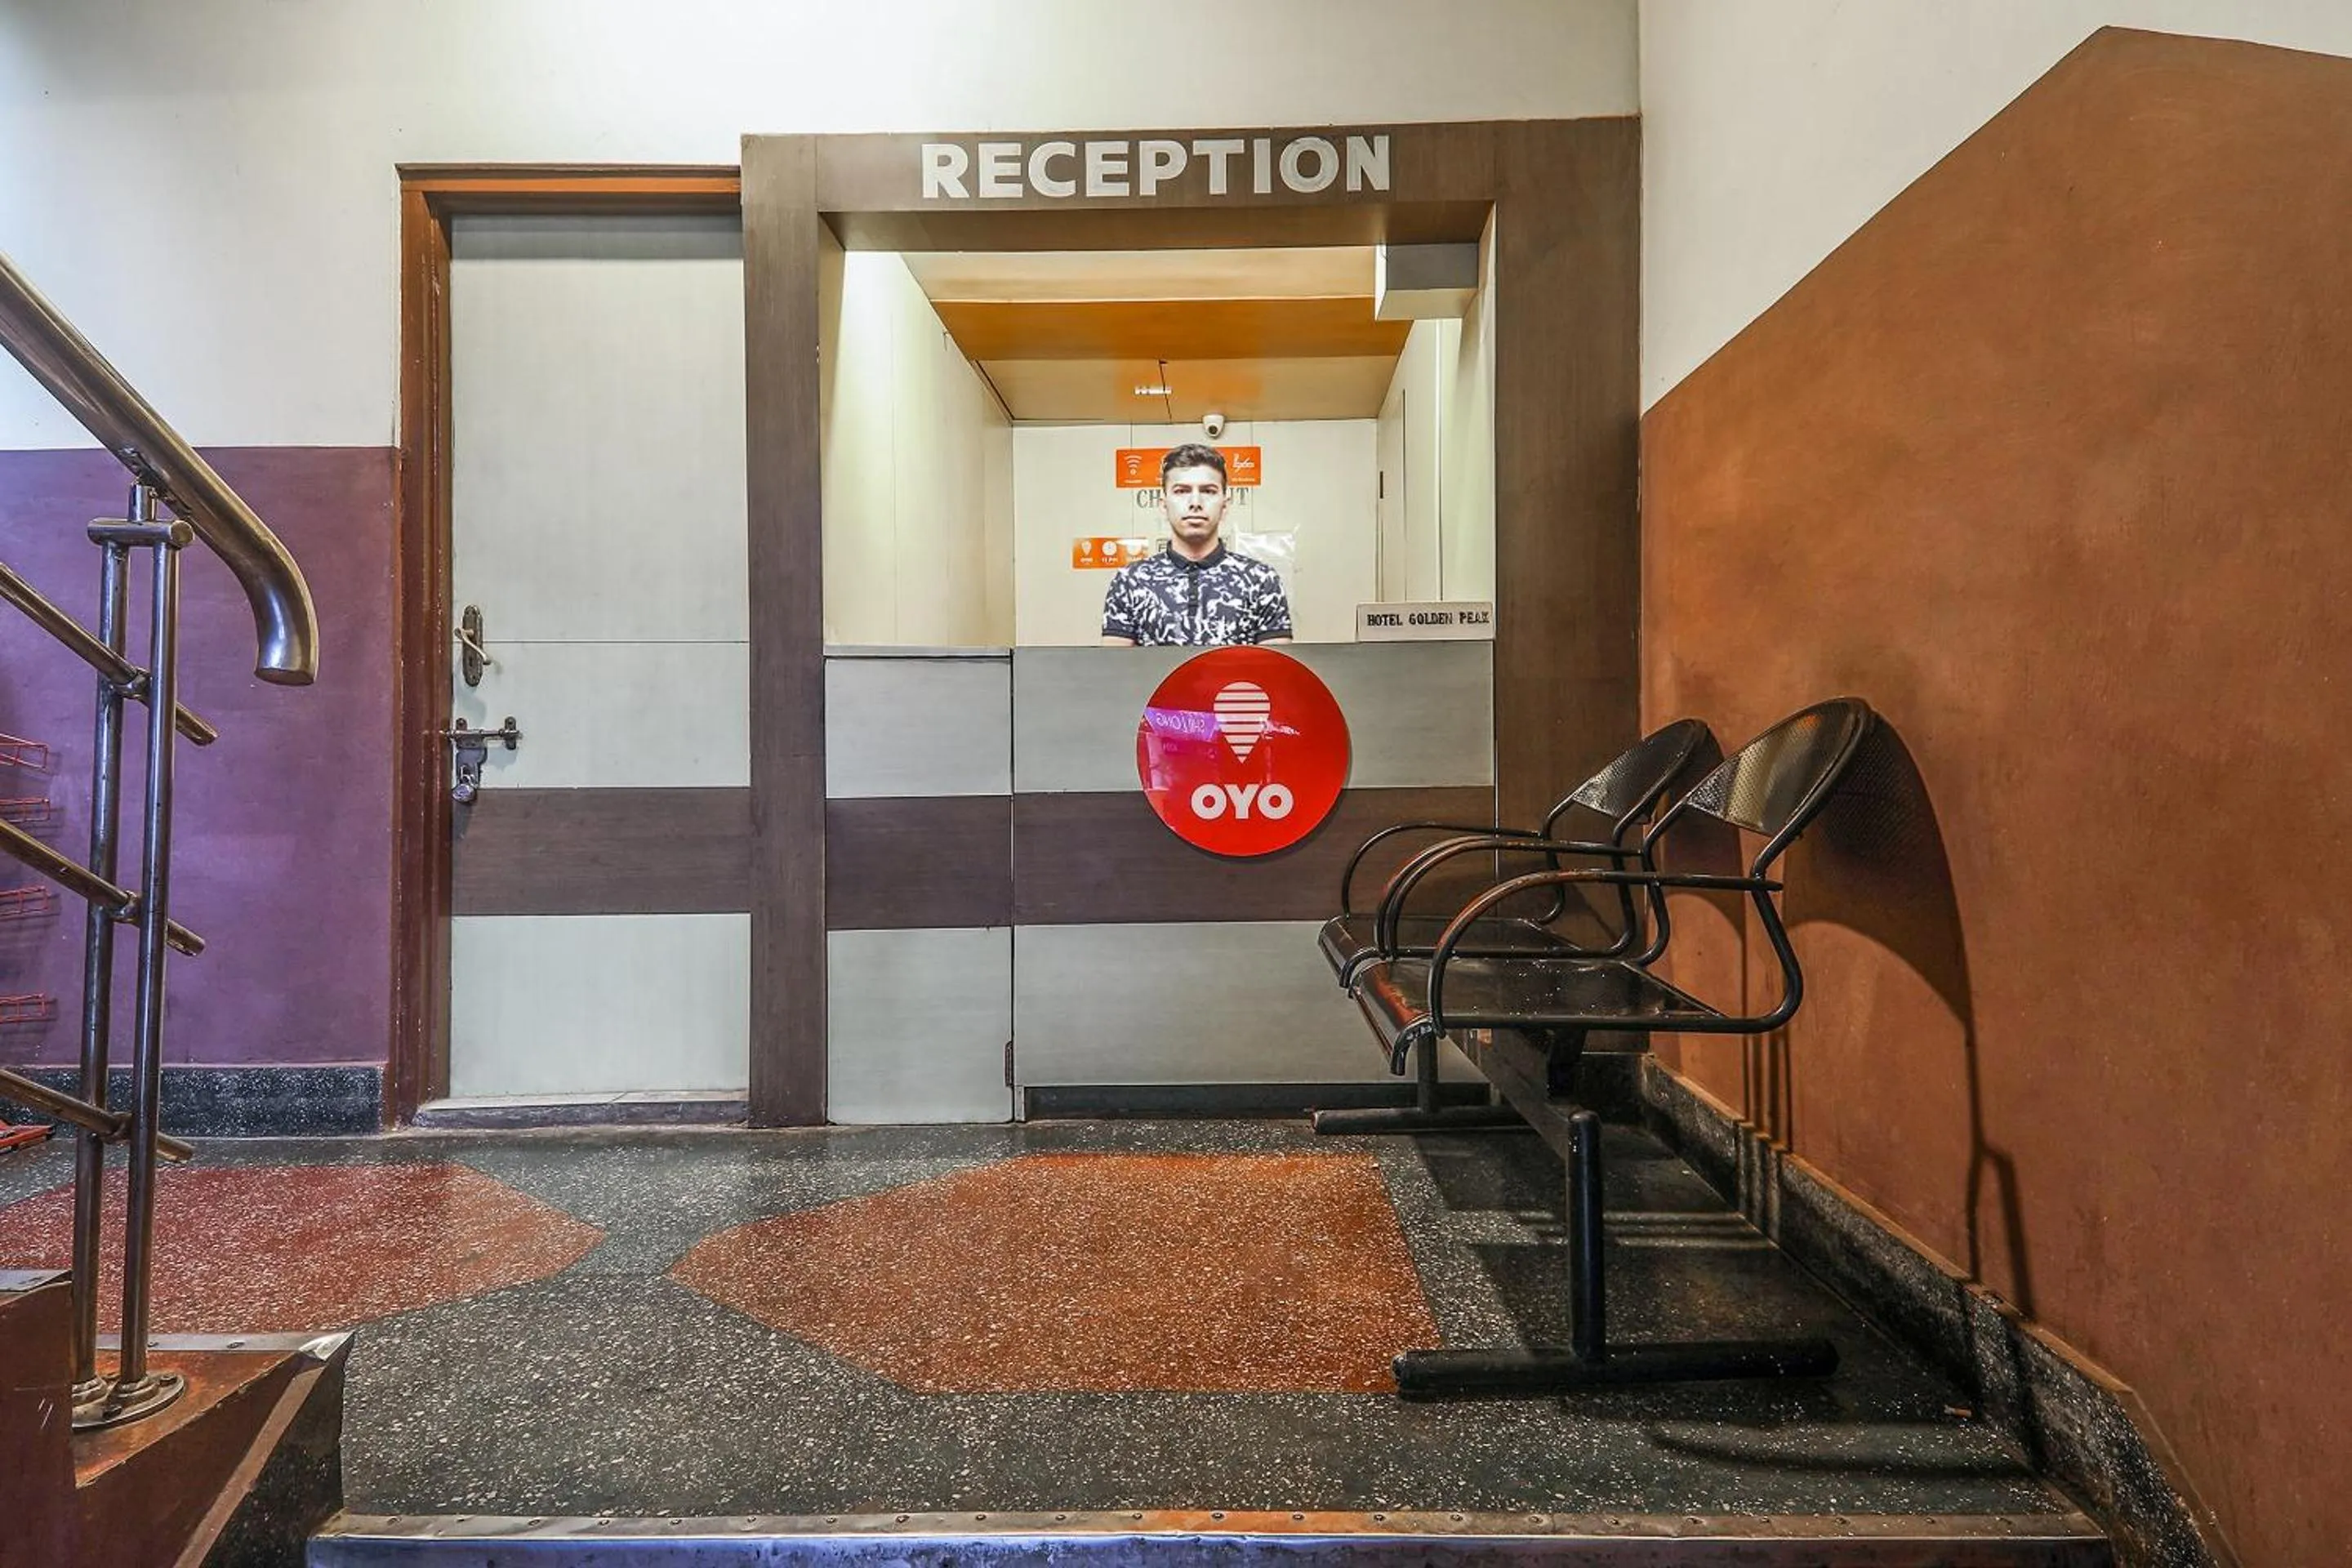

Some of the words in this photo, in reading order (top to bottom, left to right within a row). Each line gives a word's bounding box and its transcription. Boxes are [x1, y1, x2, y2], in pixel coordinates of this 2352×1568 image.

[920, 135, 1391, 199] RECEPTION
[1366, 613, 1404, 626] HOTEL
[1408, 612, 1454, 626] GOLDEN
[1191, 783, 1294, 820] OYO
